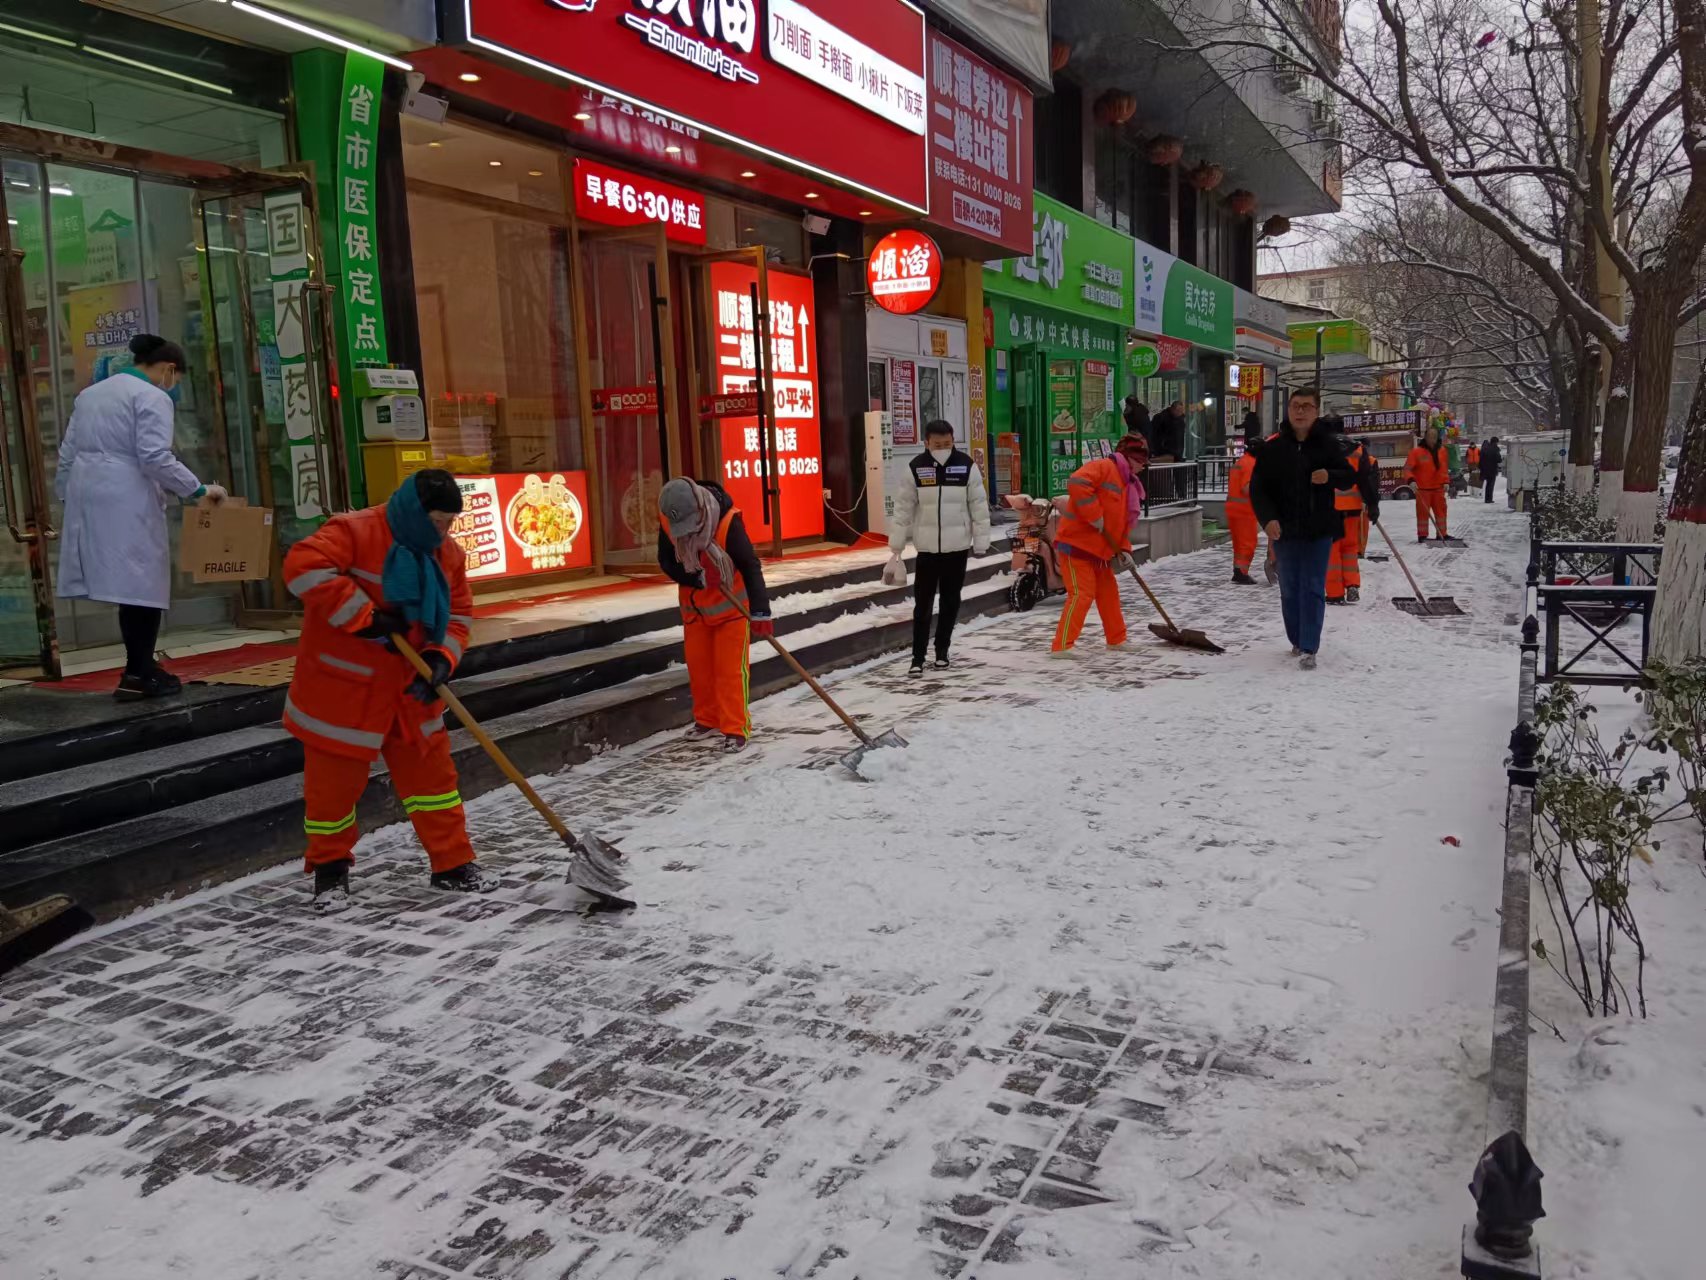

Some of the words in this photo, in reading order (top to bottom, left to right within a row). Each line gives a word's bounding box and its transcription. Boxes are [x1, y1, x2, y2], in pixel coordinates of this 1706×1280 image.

[773, 12, 812, 60] 刀削面
[894, 81, 923, 119] 下饭菜
[934, 101, 1009, 181] 二楼出租
[586, 173, 702, 230] 早餐6:30供应
[953, 196, 1001, 231] 面积420平米
[984, 183, 1002, 203] 0000
[1004, 194, 1022, 211] 8026
[344, 84, 382, 364] 省市医保定点
[725, 460, 749, 478] 131
[789, 457, 819, 475] 8026
[204, 561, 247, 574] FRAGILE
